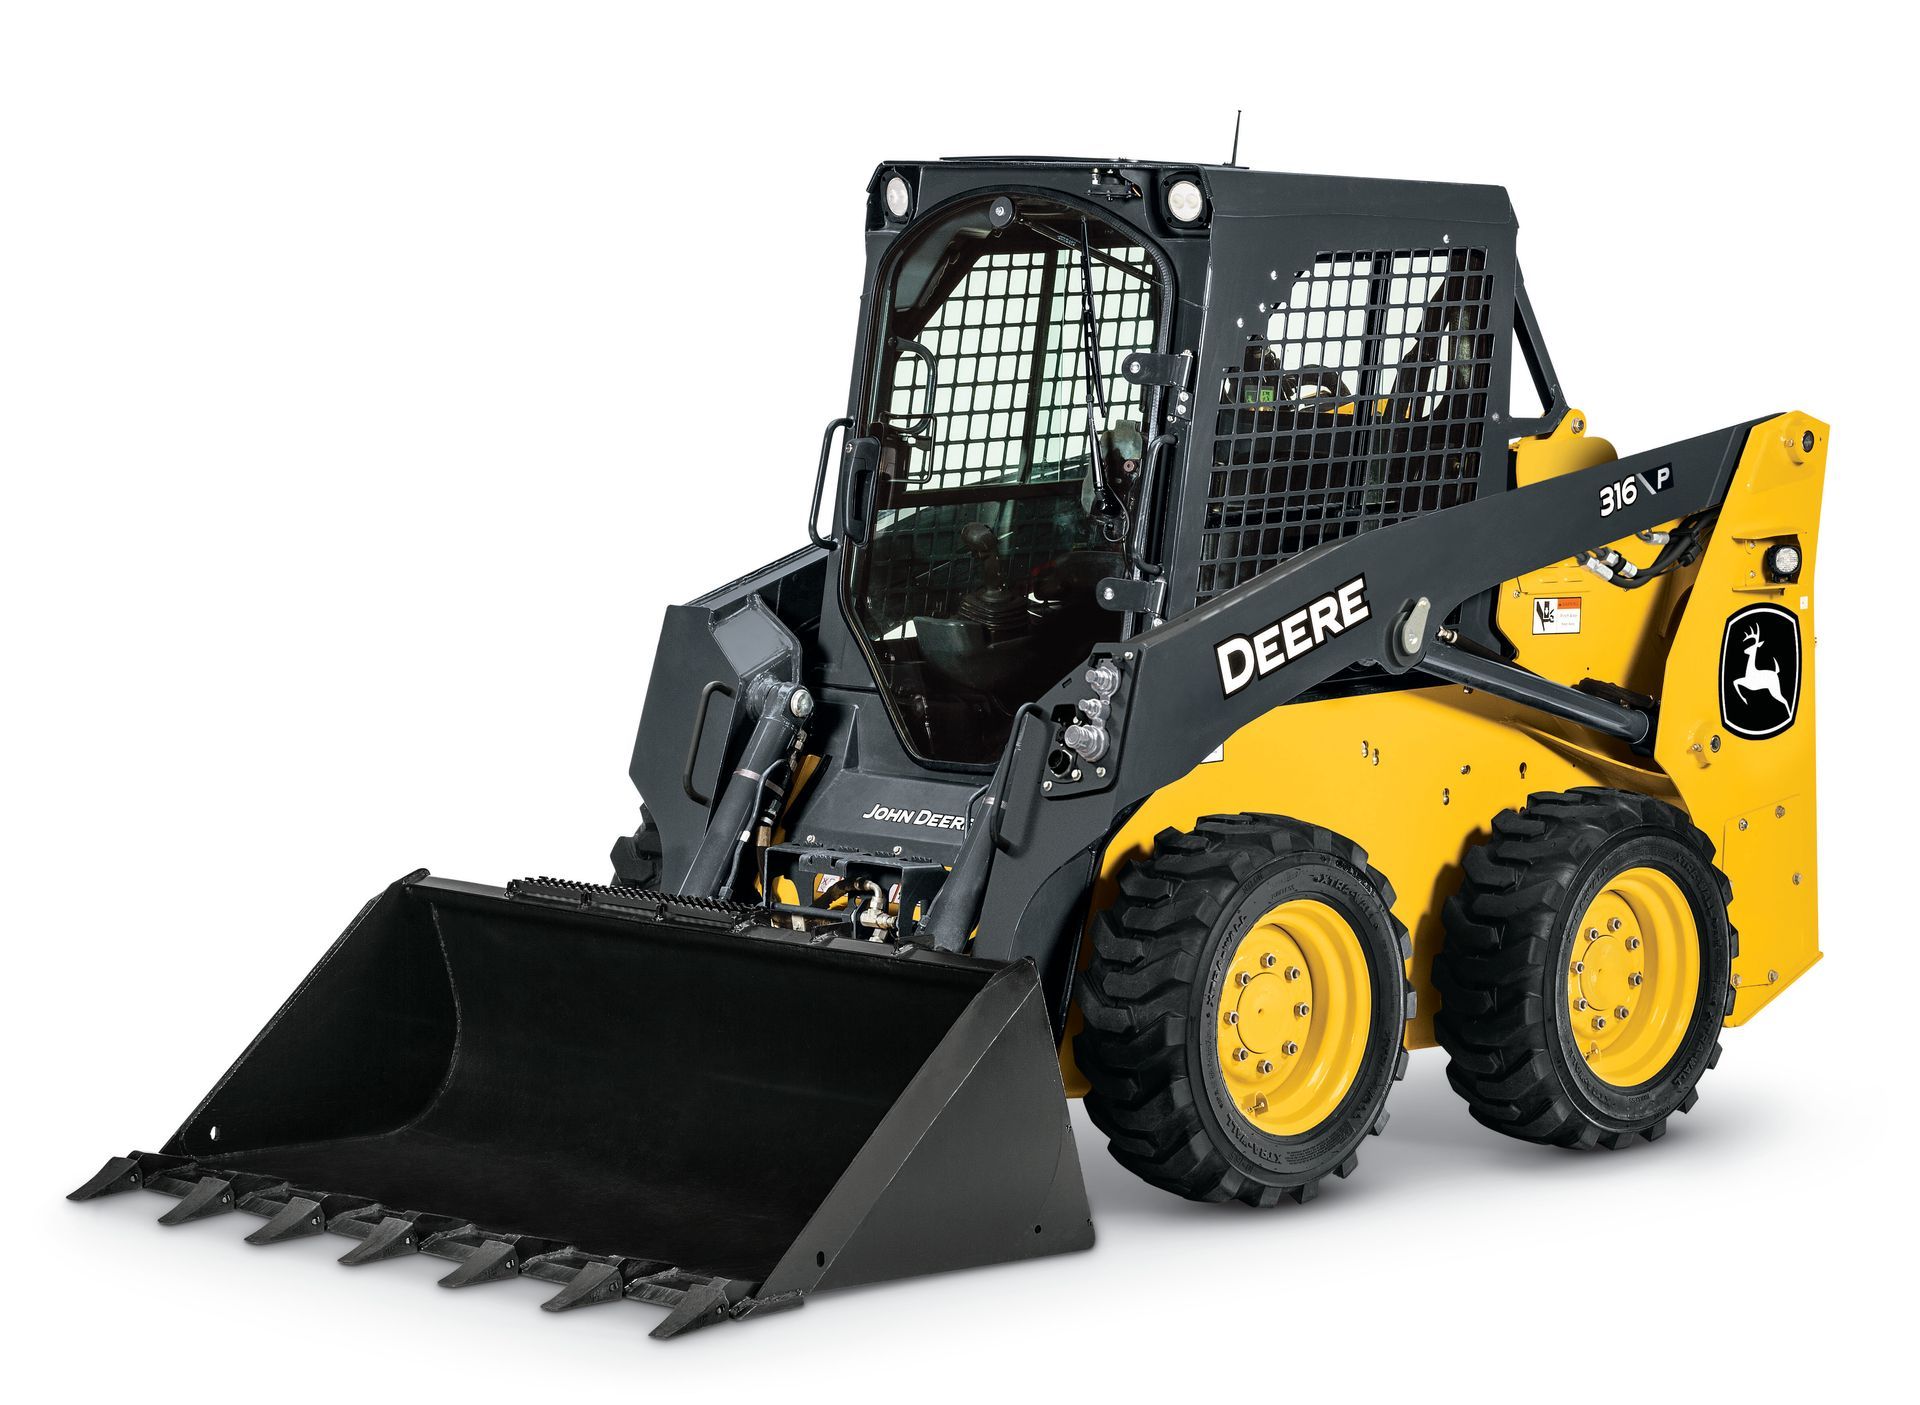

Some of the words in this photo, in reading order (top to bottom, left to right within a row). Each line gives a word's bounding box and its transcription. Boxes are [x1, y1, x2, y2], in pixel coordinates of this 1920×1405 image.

[1599, 475, 1638, 517] 316
[1657, 467, 1671, 490] P
[1216, 576, 1370, 696] DEERE
[862, 803, 915, 825] JOHN
